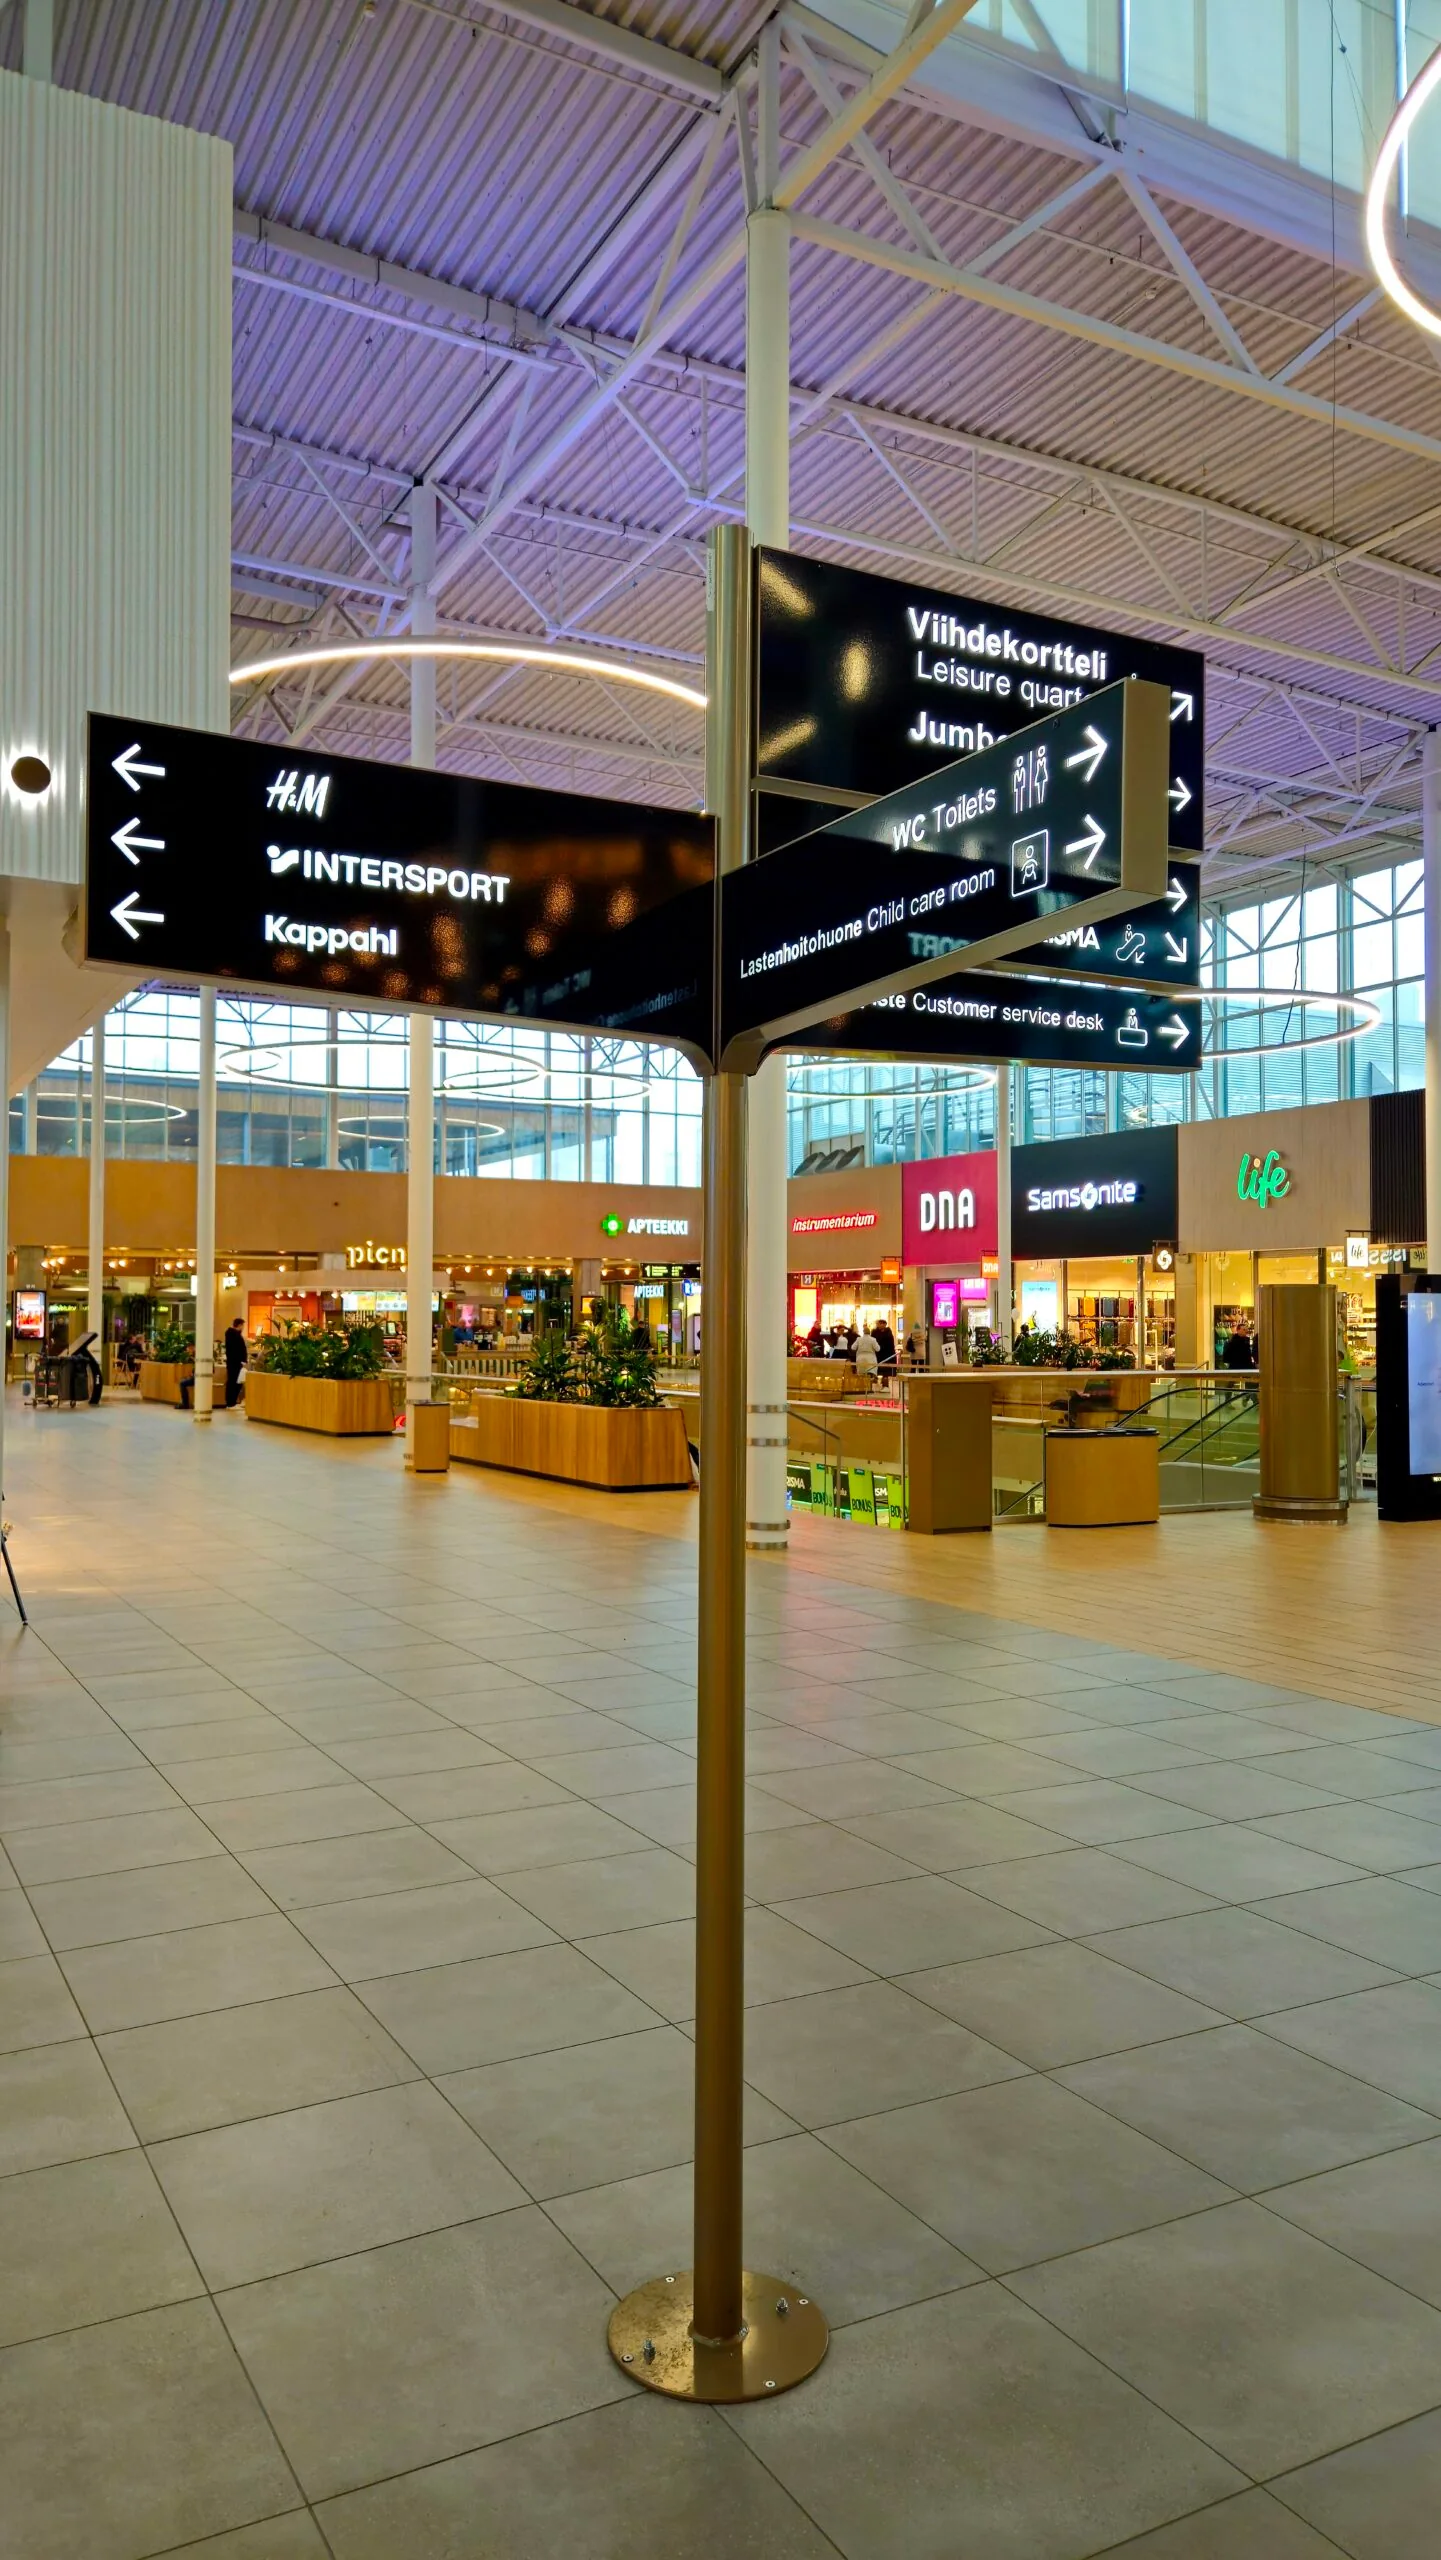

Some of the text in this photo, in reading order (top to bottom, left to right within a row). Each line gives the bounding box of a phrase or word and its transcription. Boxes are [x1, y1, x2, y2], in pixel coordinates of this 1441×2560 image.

[907, 607, 1107, 680] Viihdekortteli
[917, 650, 1091, 708] Leisure quart
[908, 711, 1010, 751] Jumb
[266, 769, 331, 818] H&M
[892, 787, 997, 852] WC Toilets
[303, 849, 511, 903] INTERSPORT
[264, 914, 398, 956] Kappahl
[740, 868, 995, 979] Lastenhoitohuone Child care room
[912, 992, 998, 1020] Customer
[1002, 1006, 1061, 1027] service
[1066, 1011, 1105, 1032] desk
[1237, 1150, 1291, 1209] life
[627, 1218, 689, 1236] APTEEKKI
[793, 1212, 875, 1232] instrumentarium
[920, 1188, 975, 1232] DNA
[634, 1284, 665, 1299] APTEEKKI
[851, 1498, 873, 1513] BONUS
